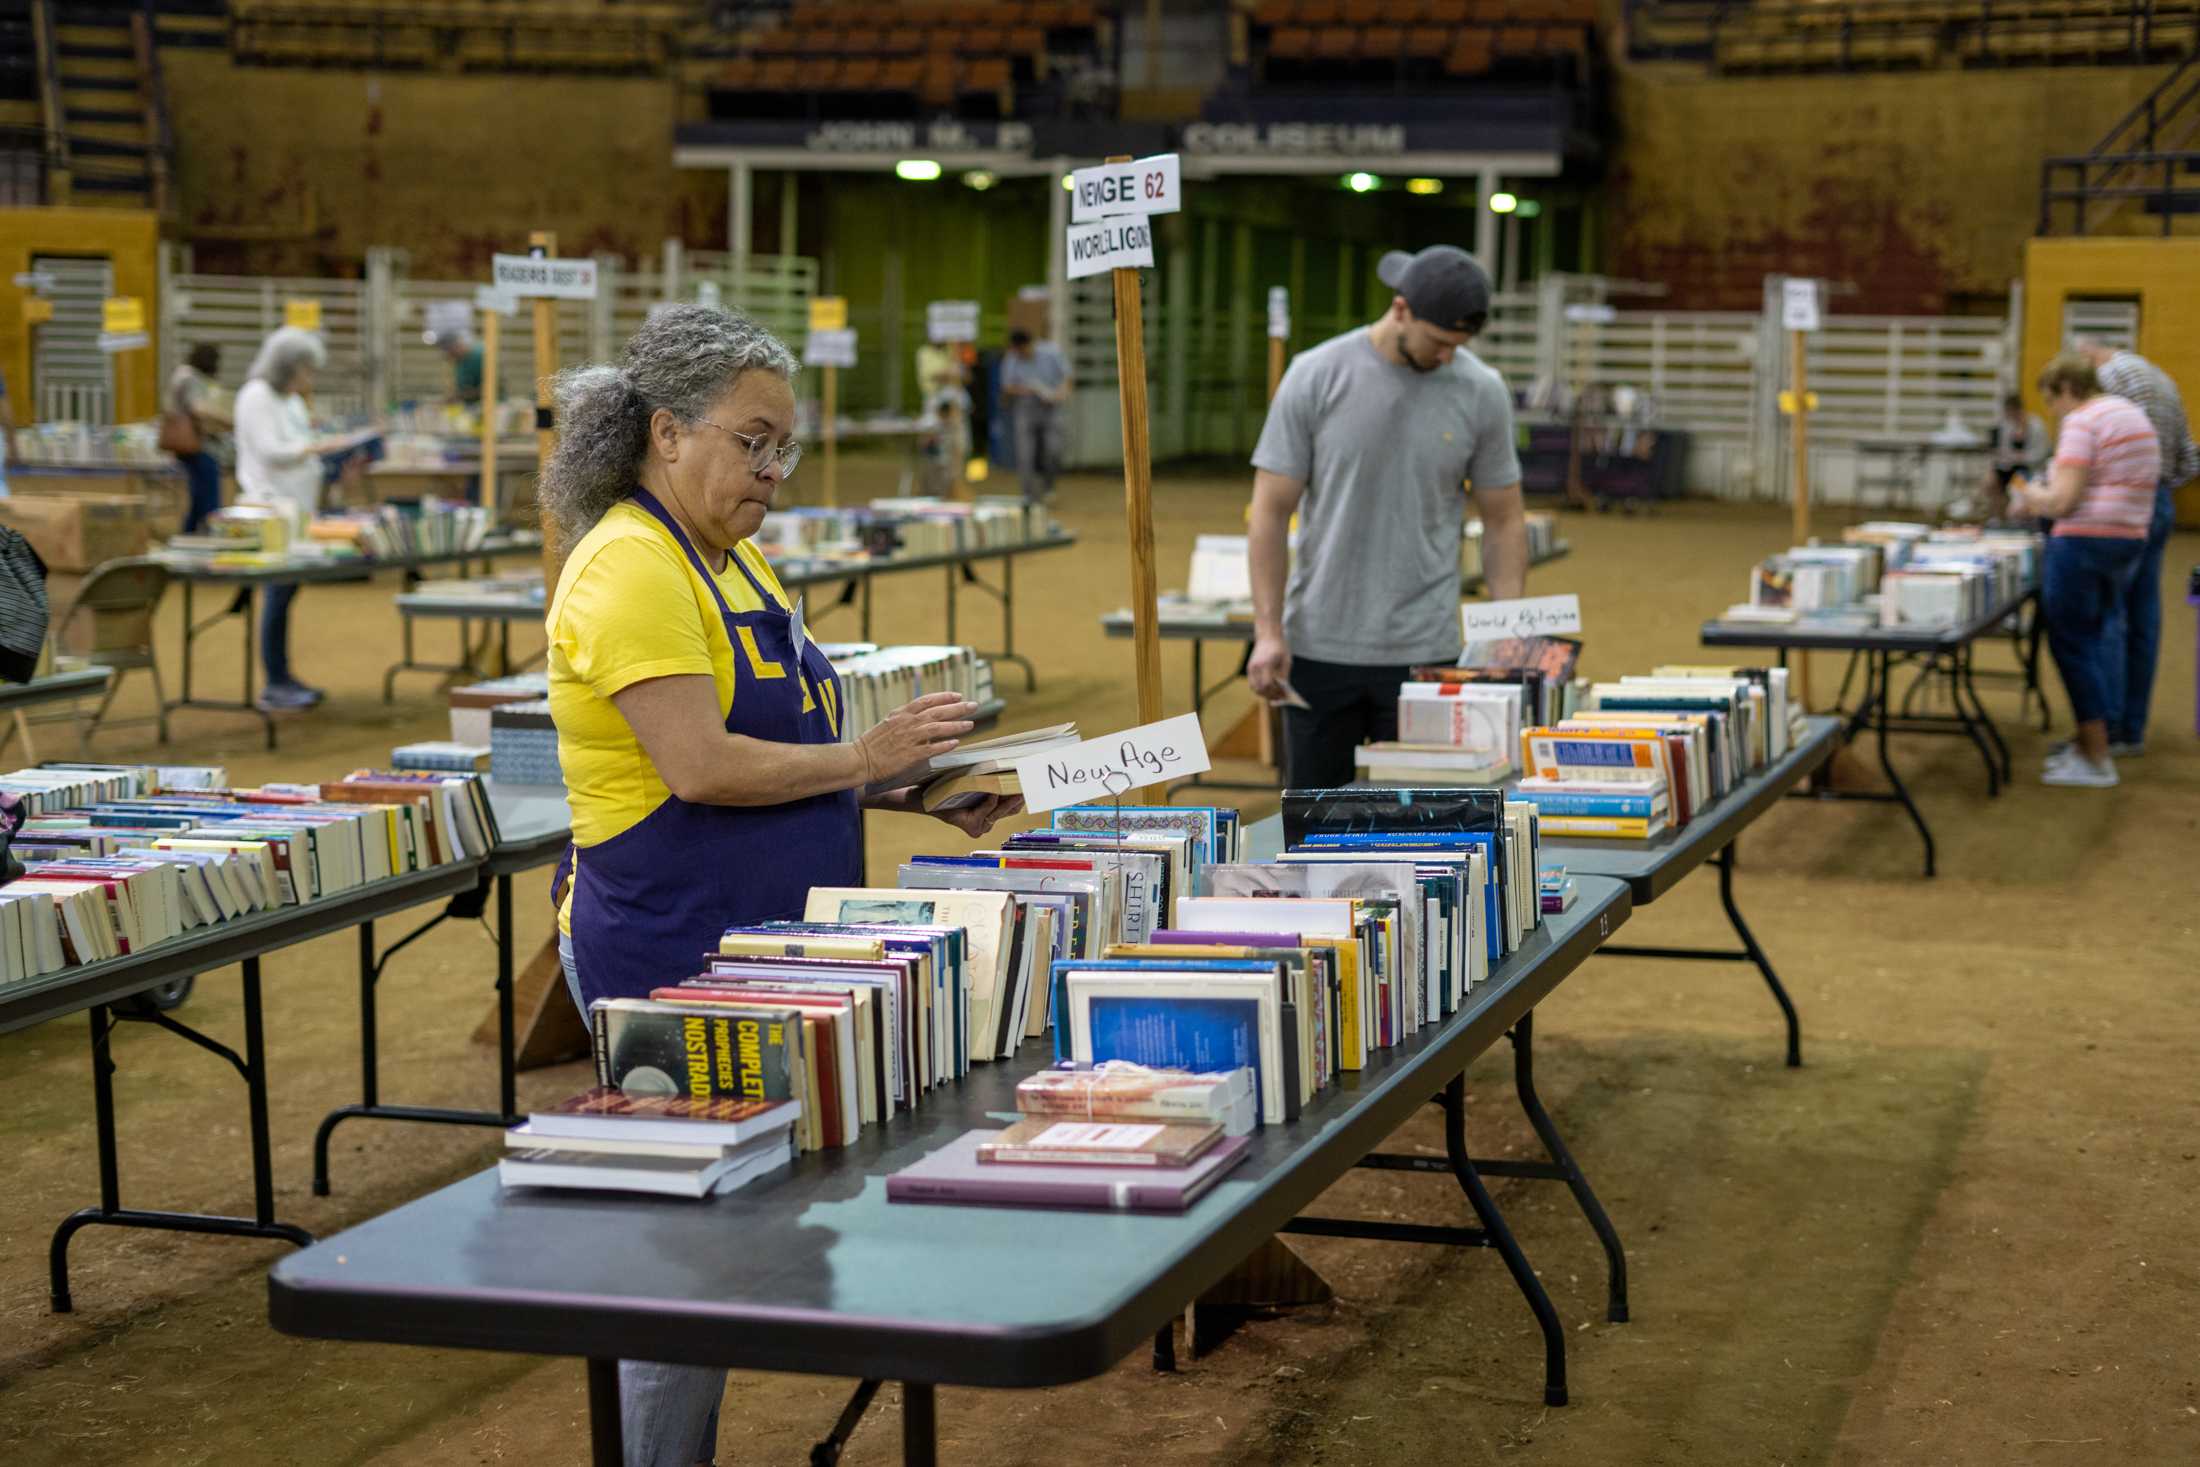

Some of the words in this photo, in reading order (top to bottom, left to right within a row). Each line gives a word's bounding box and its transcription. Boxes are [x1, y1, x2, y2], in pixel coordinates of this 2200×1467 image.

[1184, 122, 1406, 150] COLISEUM
[1144, 171, 1165, 199] 62
[1048, 761, 1112, 789] New
[1120, 741, 1181, 774] Age
[684, 1015, 712, 1100] NOSTRAD
[713, 1016, 734, 1090] PROPHECIES
[768, 1023, 785, 1046] THE
[737, 1019, 766, 1103] COMPLET
